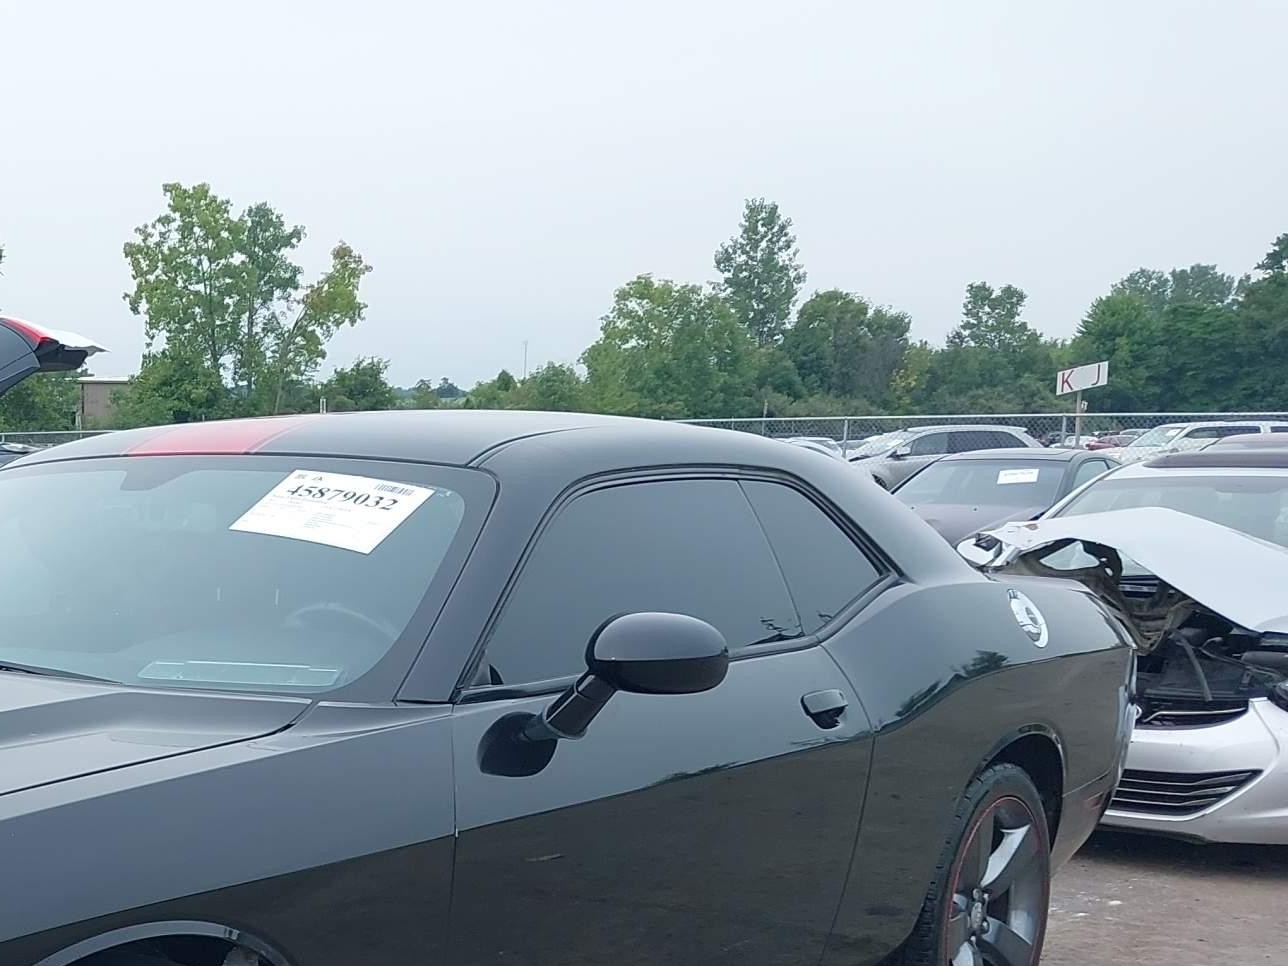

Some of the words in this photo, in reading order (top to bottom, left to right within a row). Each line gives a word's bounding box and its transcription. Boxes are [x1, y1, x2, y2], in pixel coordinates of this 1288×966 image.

[1061, 370, 1074, 393] K
[1091, 364, 1101, 386] J
[287, 484, 399, 511] 45879032
